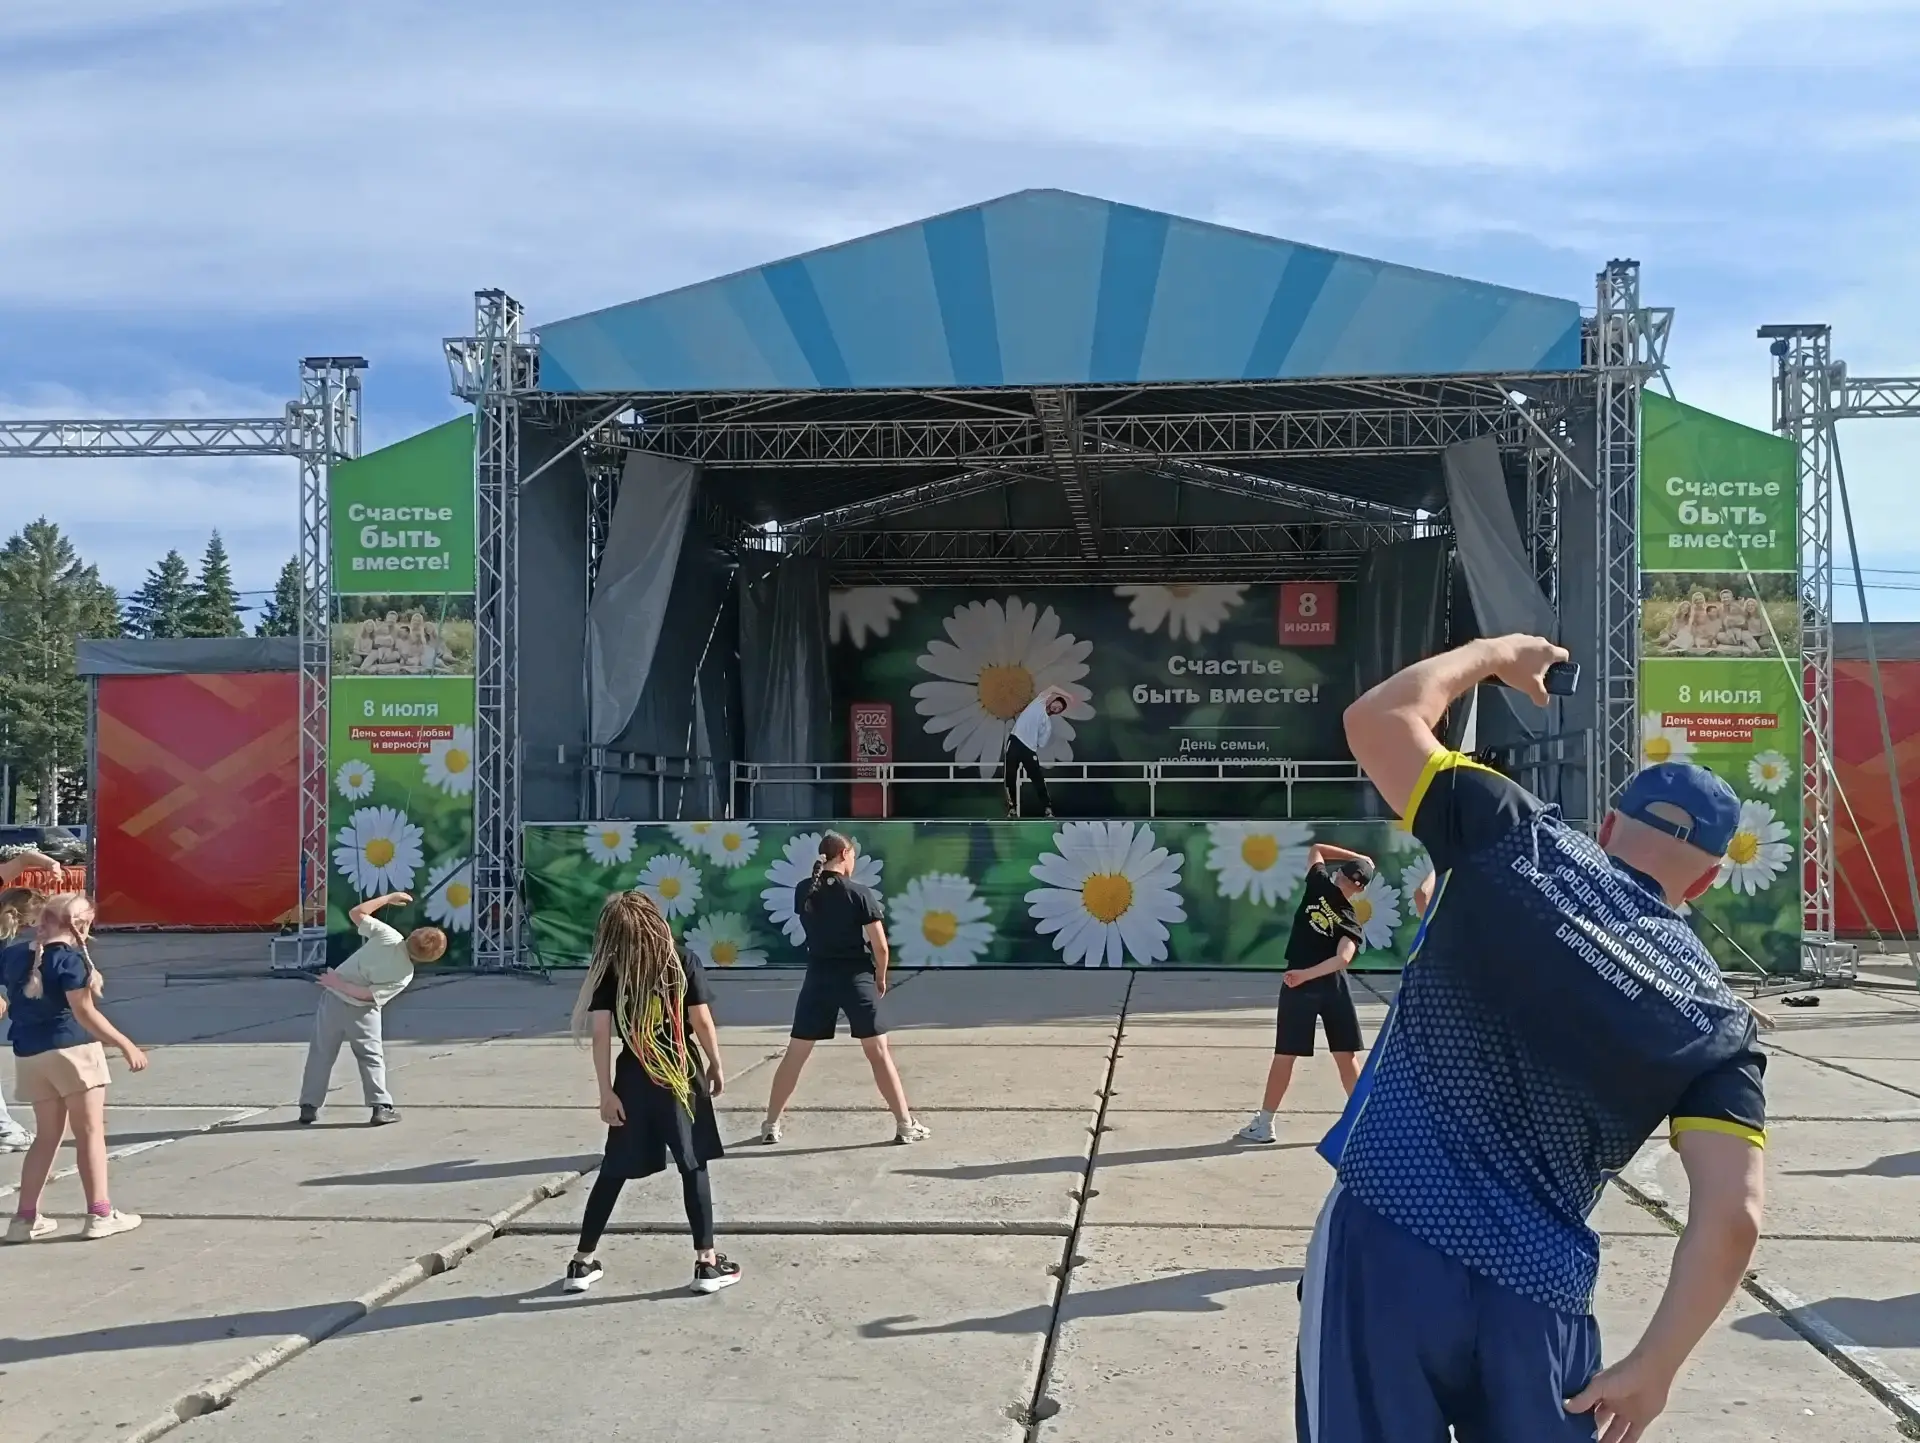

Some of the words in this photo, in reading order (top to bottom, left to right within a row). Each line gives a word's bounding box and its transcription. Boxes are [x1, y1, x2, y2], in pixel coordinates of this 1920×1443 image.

[1666, 476, 1780, 497] Счастье
[348, 503, 453, 522] Счастье
[1678, 500, 1767, 525] быть
[360, 525, 441, 548] быть
[1668, 530, 1776, 549] вместе!
[352, 552, 450, 571] вместе!
[1299, 593, 1318, 617] 8
[1284, 622, 1331, 632] июля
[1168, 655, 1284, 675] Счастье
[1133, 684, 1200, 704] быть
[1209, 683, 1319, 704] вместе!
[1678, 685, 1691, 703] 8
[1700, 689, 1762, 704] июля
[363, 700, 375, 717] 8
[382, 702, 439, 717] июля
[856, 713, 887, 725] 2026
[1665, 715, 1694, 727] День
[1737, 716, 1775, 726] любви
[351, 728, 377, 739] День
[416, 729, 451, 738] любви
[1699, 729, 1751, 739] верности
[373, 741, 379, 749] и
[382, 741, 429, 751] верности
[1180, 738, 1217, 752] День
[1220, 741, 1270, 752] семьи,
[1555, 838, 1640, 921] ОБЩЕСТВЕННАЯ
[1637, 916, 1719, 989] ОРГАНИЗАЦИЯ
[1555, 864, 1629, 935] «ФЕДЕРАЦИЯ
[1626, 929, 1698, 995] ВОЛЕЙБОЛА
[1510, 855, 1579, 920] ЕВРЕЙСКОЙ
[1574, 913, 1654, 983] АВТОНОМНОЙ
[1655, 977, 1714, 1035] ОБЛАСТИ»
[1555, 922, 1643, 1001] БИРОБИДЖАН
